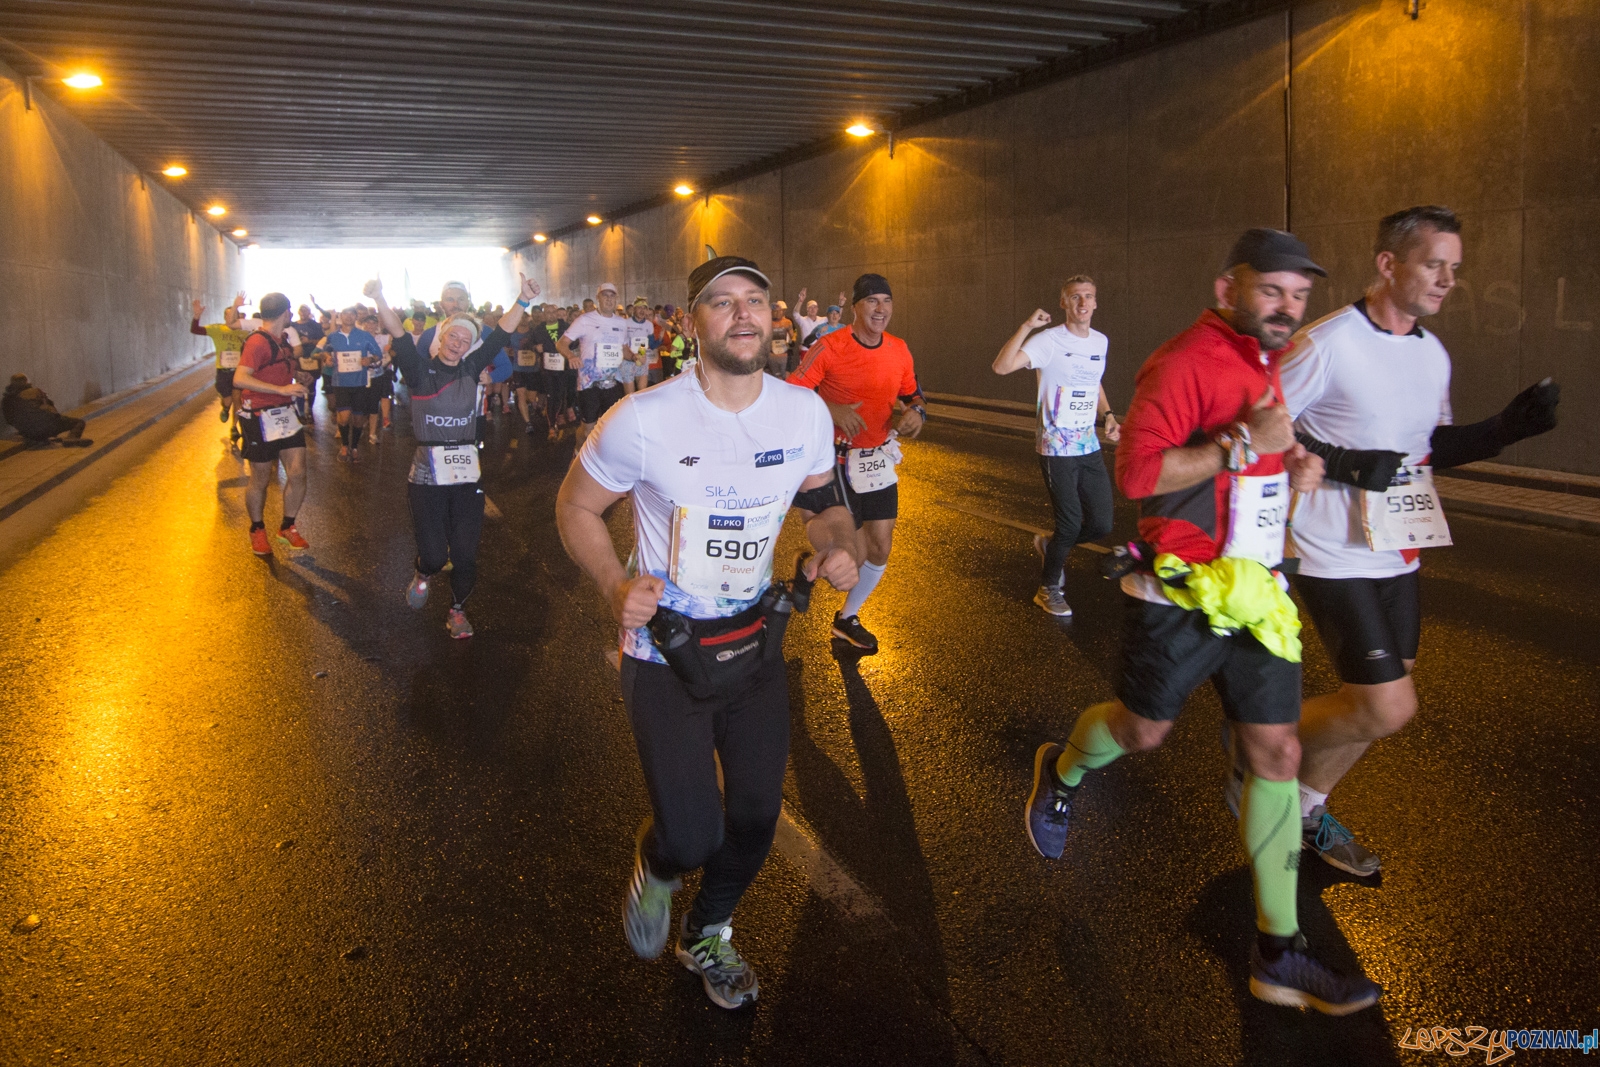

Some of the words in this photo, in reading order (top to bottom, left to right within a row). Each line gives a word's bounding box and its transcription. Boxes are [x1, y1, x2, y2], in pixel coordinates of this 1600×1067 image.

[1069, 400, 1094, 411] 6239
[443, 454, 472, 465] 6656
[679, 455, 701, 467] 4F
[858, 459, 886, 473] 3264
[705, 485, 738, 498] SIŁA
[1387, 494, 1435, 513] 5998
[1402, 516, 1433, 524] Tomasz
[706, 536, 770, 561] 6907
[722, 565, 755, 575] Paweł
